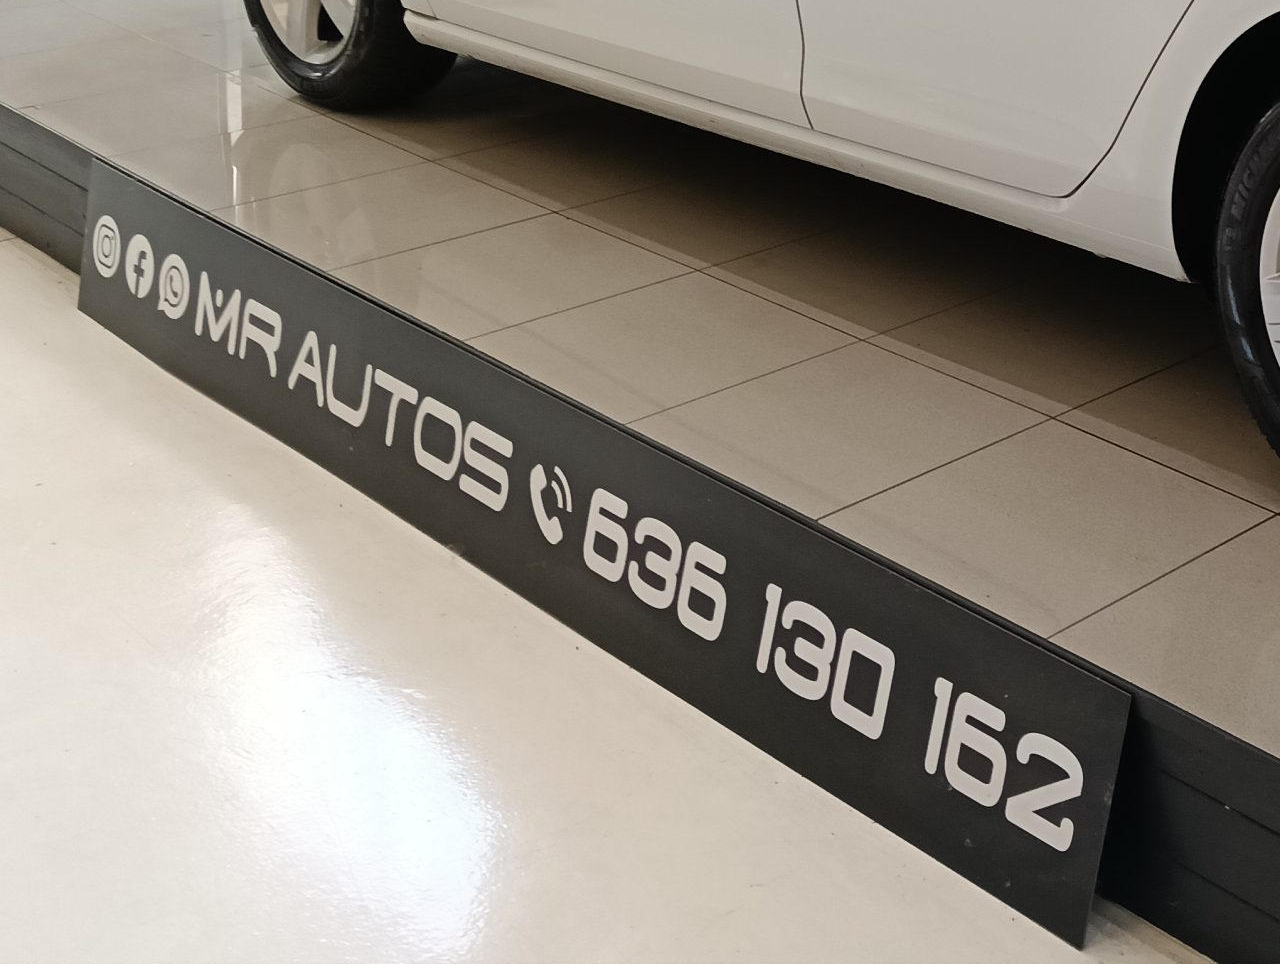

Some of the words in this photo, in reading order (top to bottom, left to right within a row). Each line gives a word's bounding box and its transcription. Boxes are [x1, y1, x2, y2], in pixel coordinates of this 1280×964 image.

[194, 270, 283, 378] MR
[287, 330, 514, 512] AUTOS
[583, 487, 728, 642] 636
[756, 583, 896, 740] 130
[924, 676, 1084, 852] 162
